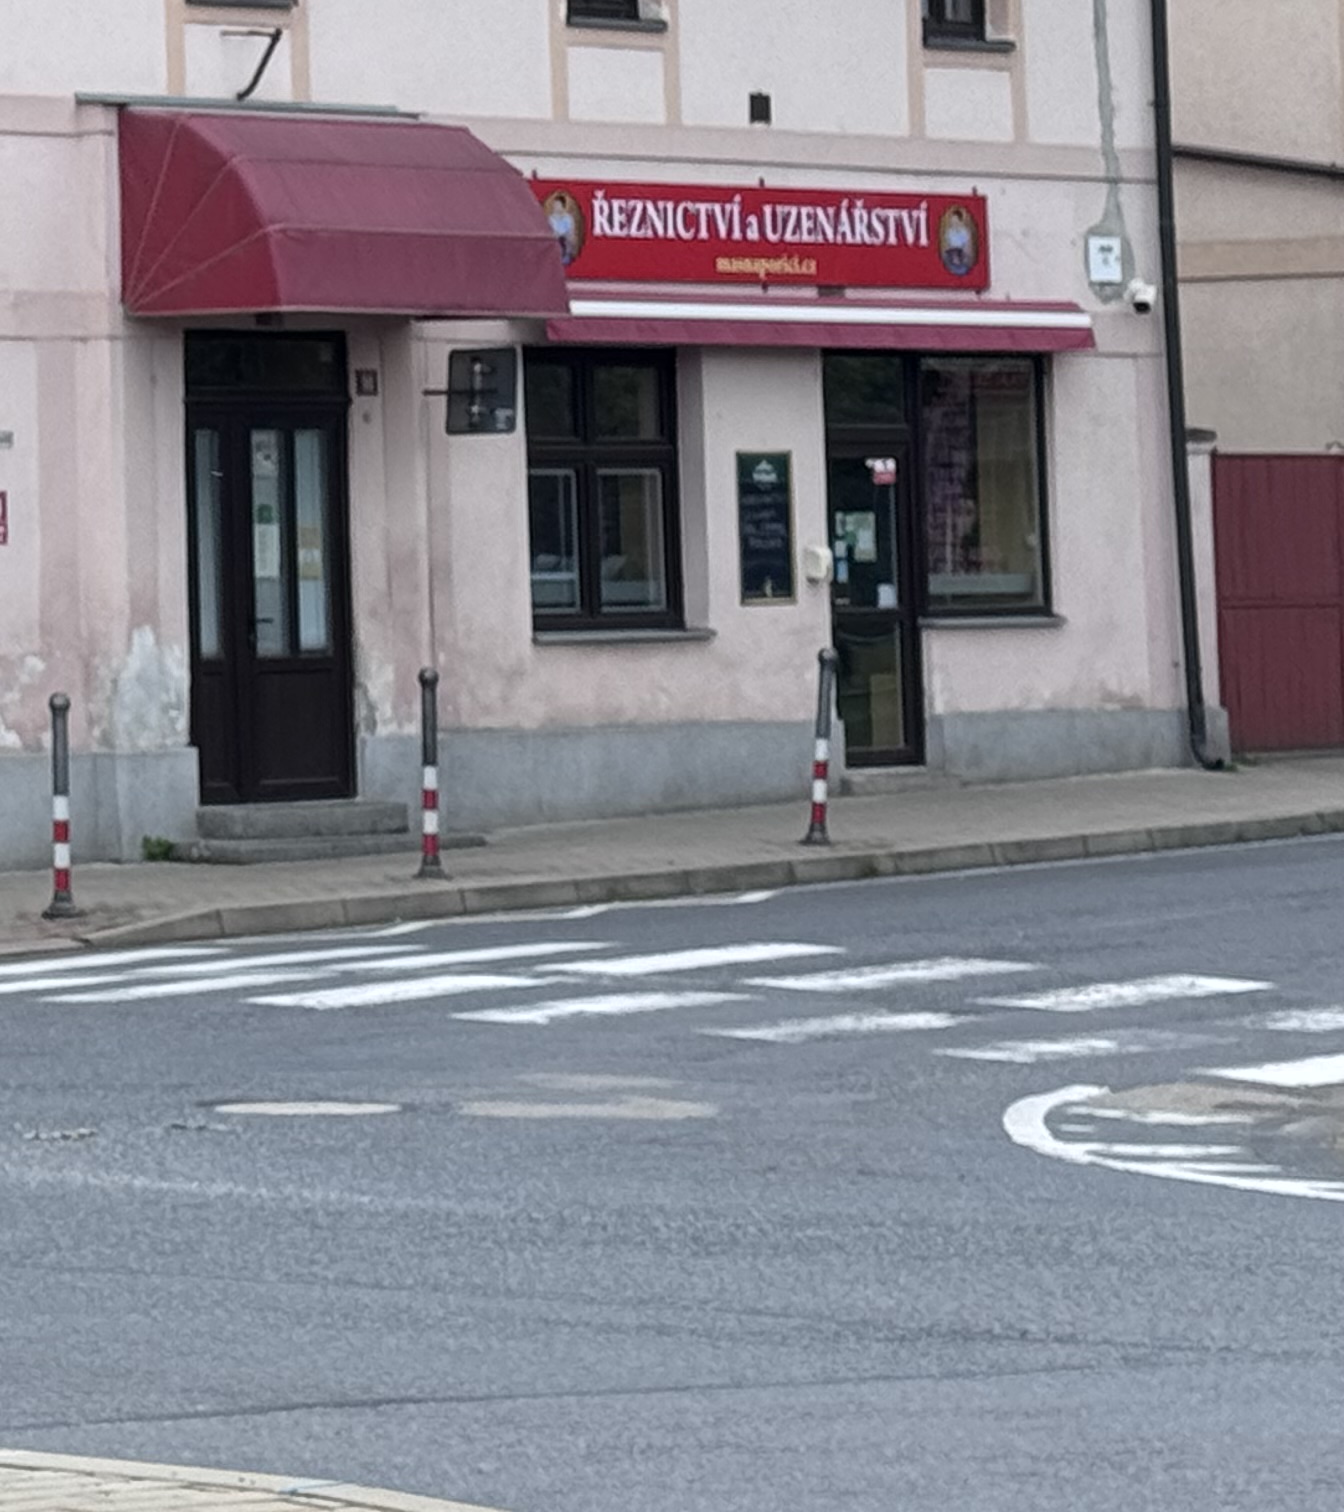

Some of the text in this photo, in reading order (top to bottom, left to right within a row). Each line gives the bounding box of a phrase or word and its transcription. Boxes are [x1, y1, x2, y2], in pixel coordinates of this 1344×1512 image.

[592, 190, 929, 248] ŘEZNICTVÍ a UZENÁŘSTVÍ
